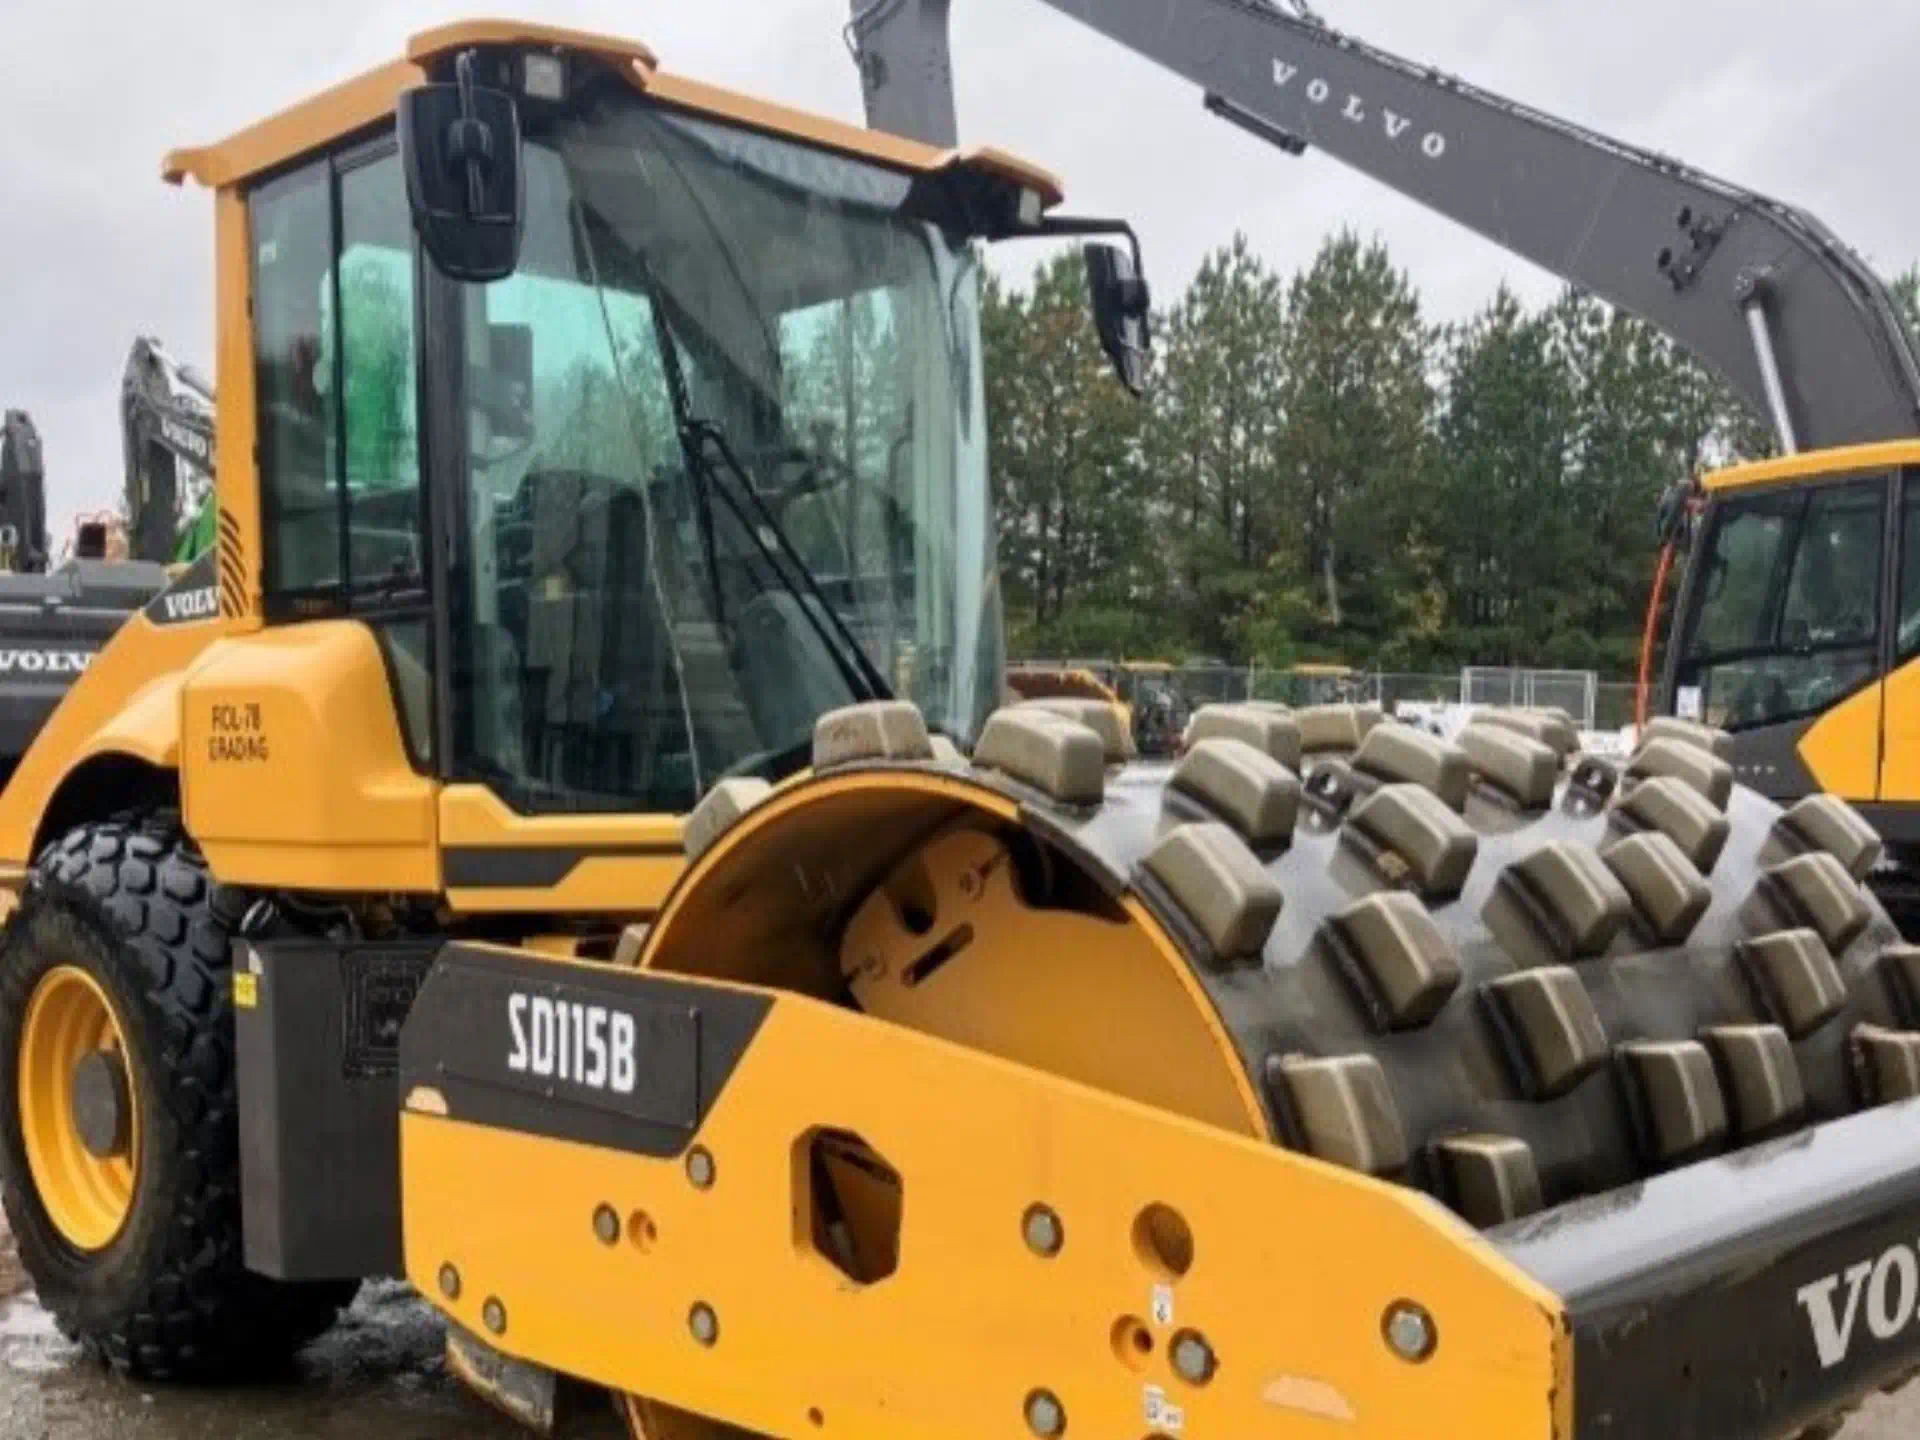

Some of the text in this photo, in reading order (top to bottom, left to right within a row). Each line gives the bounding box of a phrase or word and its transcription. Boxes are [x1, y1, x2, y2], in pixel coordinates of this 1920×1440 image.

[1273, 58, 1445, 157] VOLVO
[508, 992, 636, 1094] SD115B
[1797, 1236, 1920, 1368] VO
